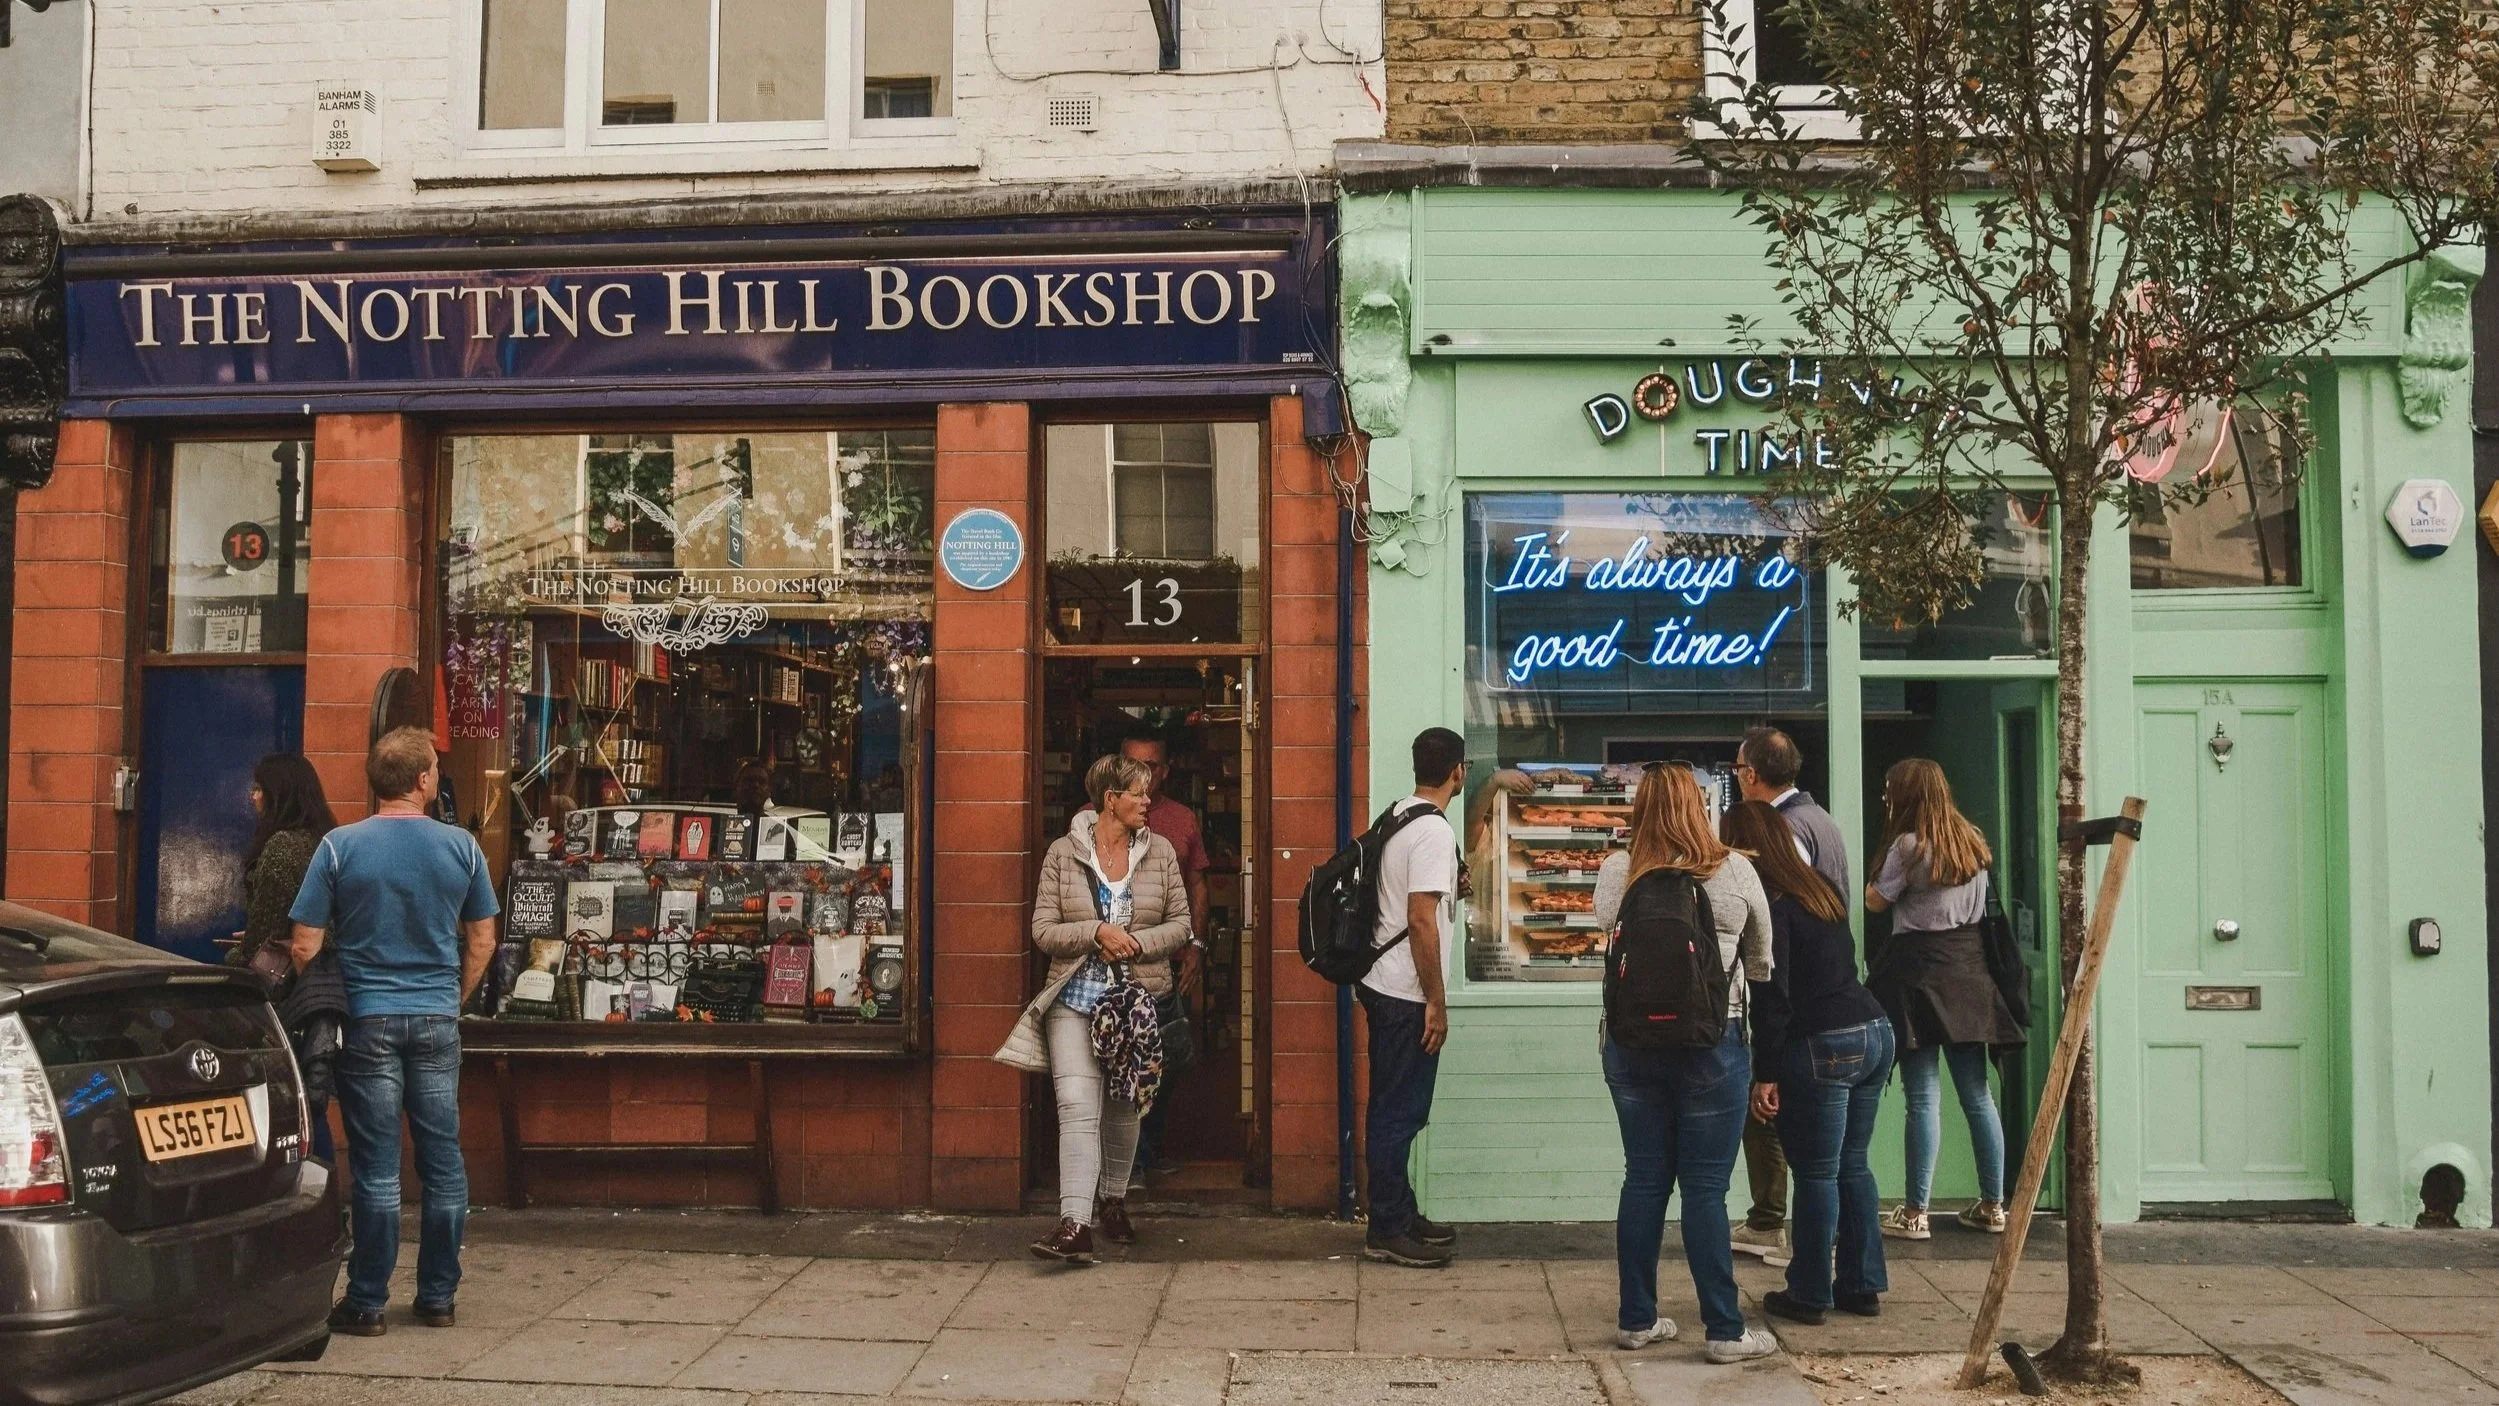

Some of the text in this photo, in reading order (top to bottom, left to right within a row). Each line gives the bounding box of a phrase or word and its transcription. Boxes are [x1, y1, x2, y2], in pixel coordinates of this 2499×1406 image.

[318, 90, 362, 101] BANHAM
[318, 101, 361, 111] ALARMS
[333, 119, 346, 128] 01
[329, 130, 349, 139] 385
[326, 141, 352, 150] 3322
[119, 266, 1276, 347] THE NOTTING HILL BOOKSHOP
[1581, 357, 1968, 445] DOUGH
[1696, 429, 1842, 476] TIME
[2410, 516, 2448, 526] LanTec
[230, 533, 263, 560] 13
[946, 541, 1017, 550] NOTTING HILL
[1493, 529, 1796, 605] It's always a
[527, 575, 845, 596] THE NOTTING HILL BOOKSHOP
[1122, 578, 1183, 626] 13
[1507, 605, 1791, 682] good time!
[2202, 688, 2236, 706] 15A
[463, 712, 482, 723] ON
[526, 886, 544, 894] THE
[521, 912, 554, 922] MAGIC
[144, 1104, 245, 1153] LS56 FZJ
